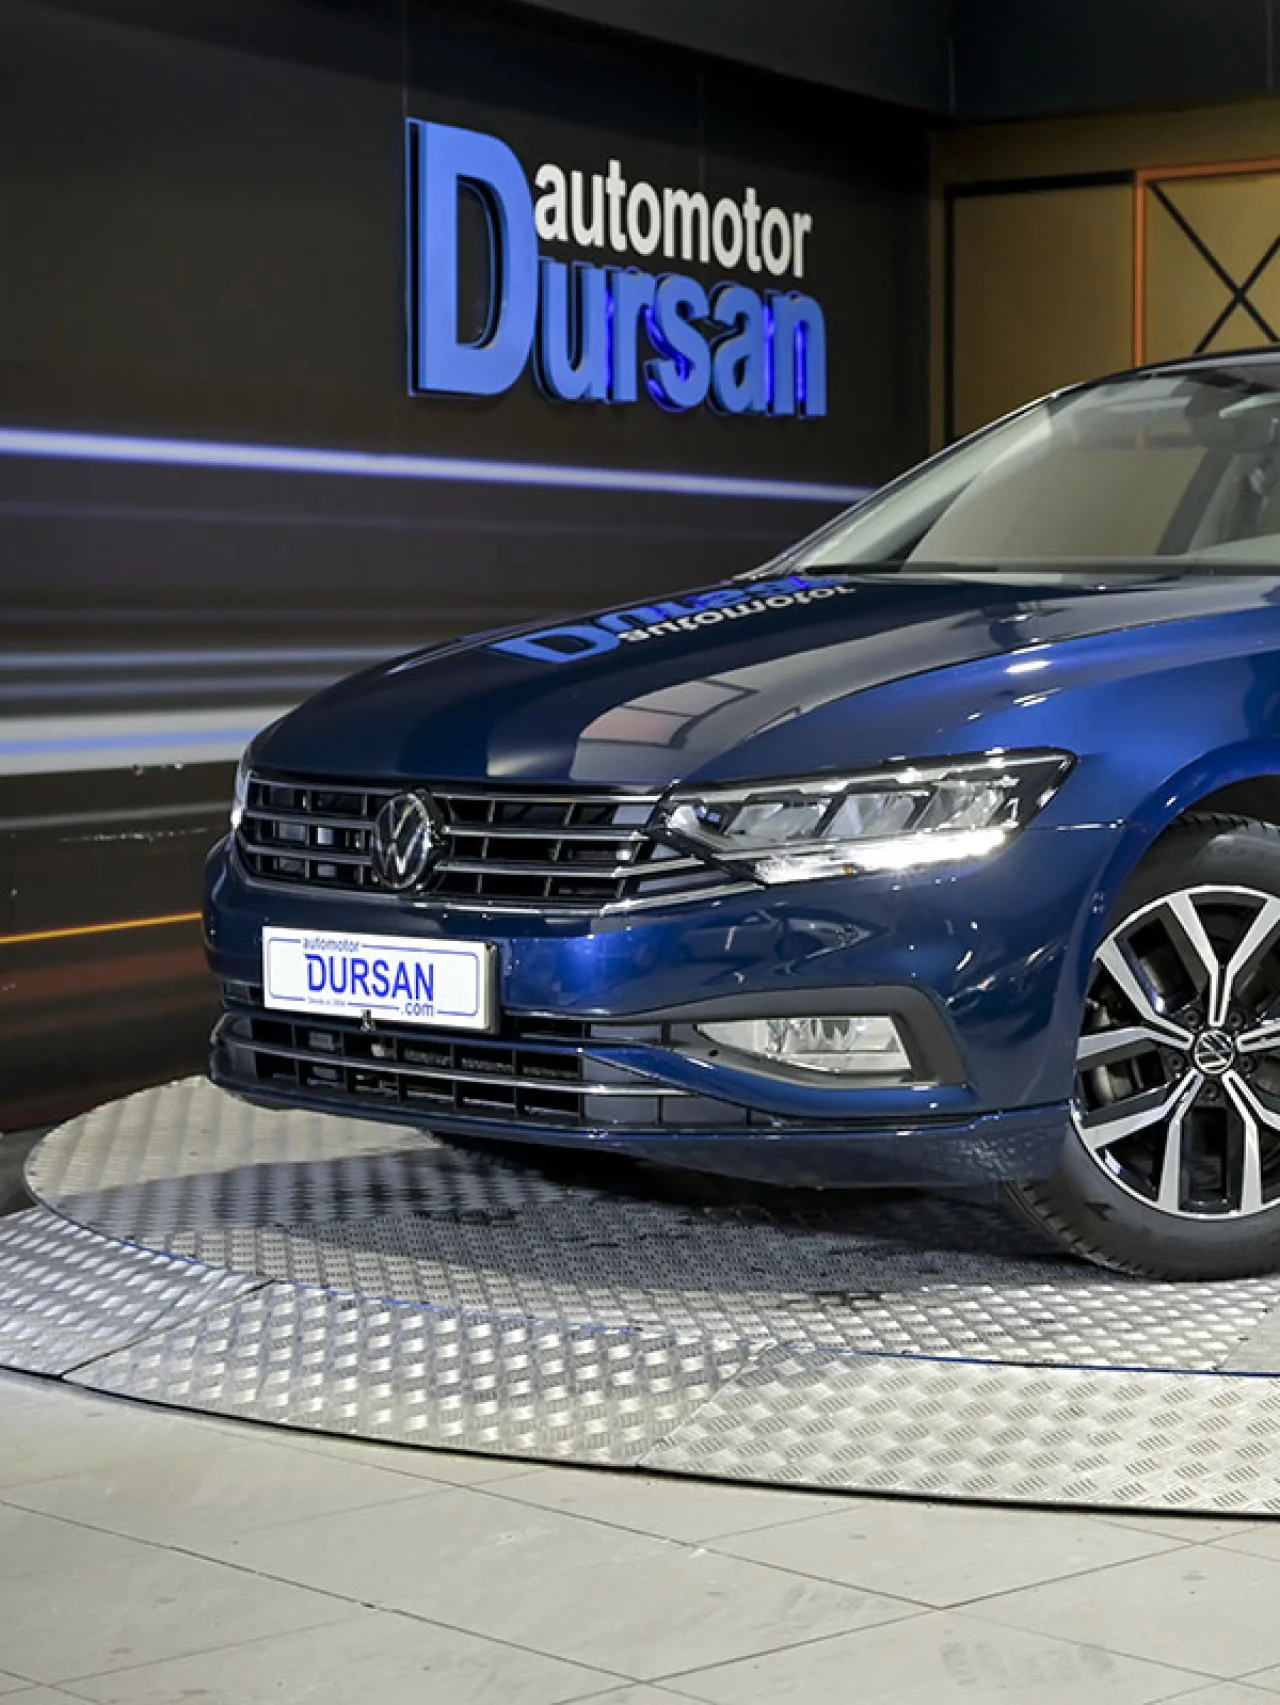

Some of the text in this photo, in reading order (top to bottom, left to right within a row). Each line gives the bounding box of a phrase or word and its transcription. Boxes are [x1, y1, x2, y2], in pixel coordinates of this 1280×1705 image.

[534, 159, 812, 278] automotor
[405, 116, 827, 418] Dursan
[303, 937, 360, 952] automotor
[304, 953, 435, 1001] DURSAN
[401, 1001, 435, 1017] .com
